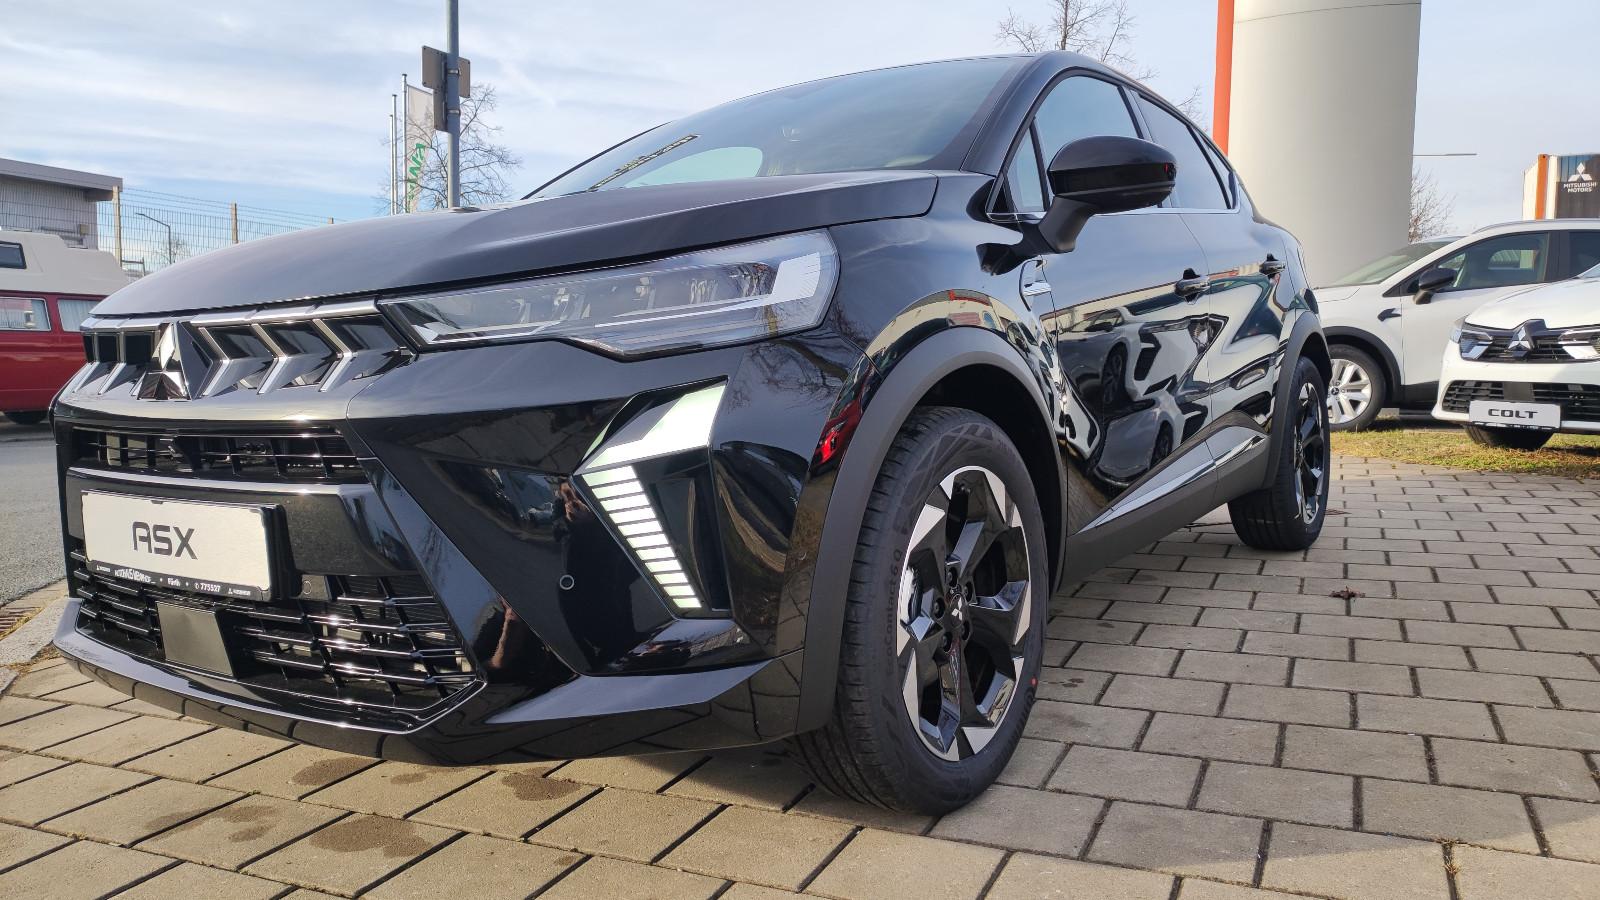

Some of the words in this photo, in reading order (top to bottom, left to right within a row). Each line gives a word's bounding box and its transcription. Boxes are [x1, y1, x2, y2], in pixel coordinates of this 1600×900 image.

[1563, 181, 1597, 189] MITSUBISHI
[1488, 408, 1538, 419] COLT
[132, 521, 198, 560] ASX
